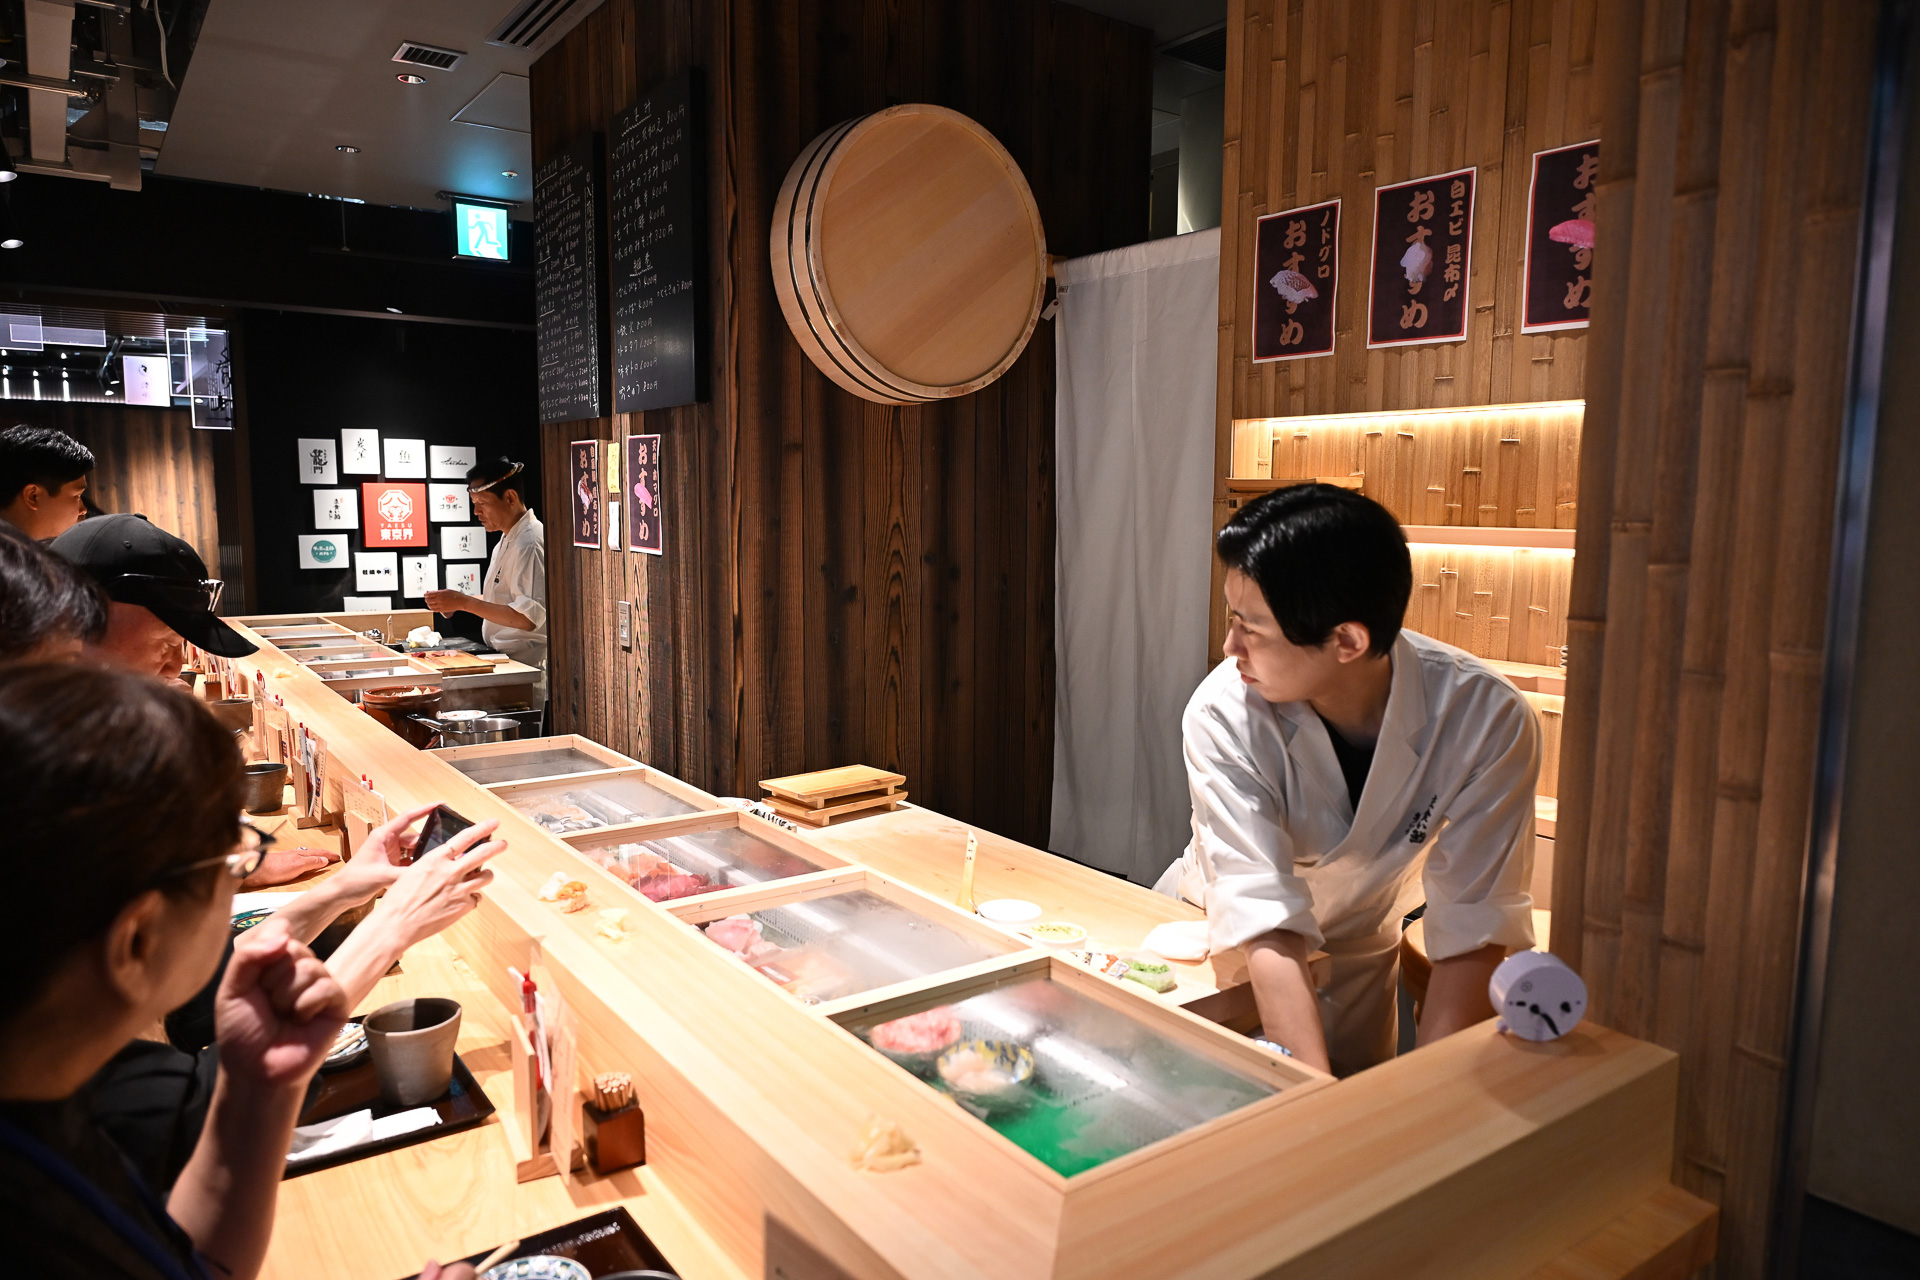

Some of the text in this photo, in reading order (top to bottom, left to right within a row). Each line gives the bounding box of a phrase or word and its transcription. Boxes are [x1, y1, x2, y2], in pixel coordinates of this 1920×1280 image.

[1318, 210, 1332, 279] ノドグロ
[380, 529, 413, 540] 東京界
